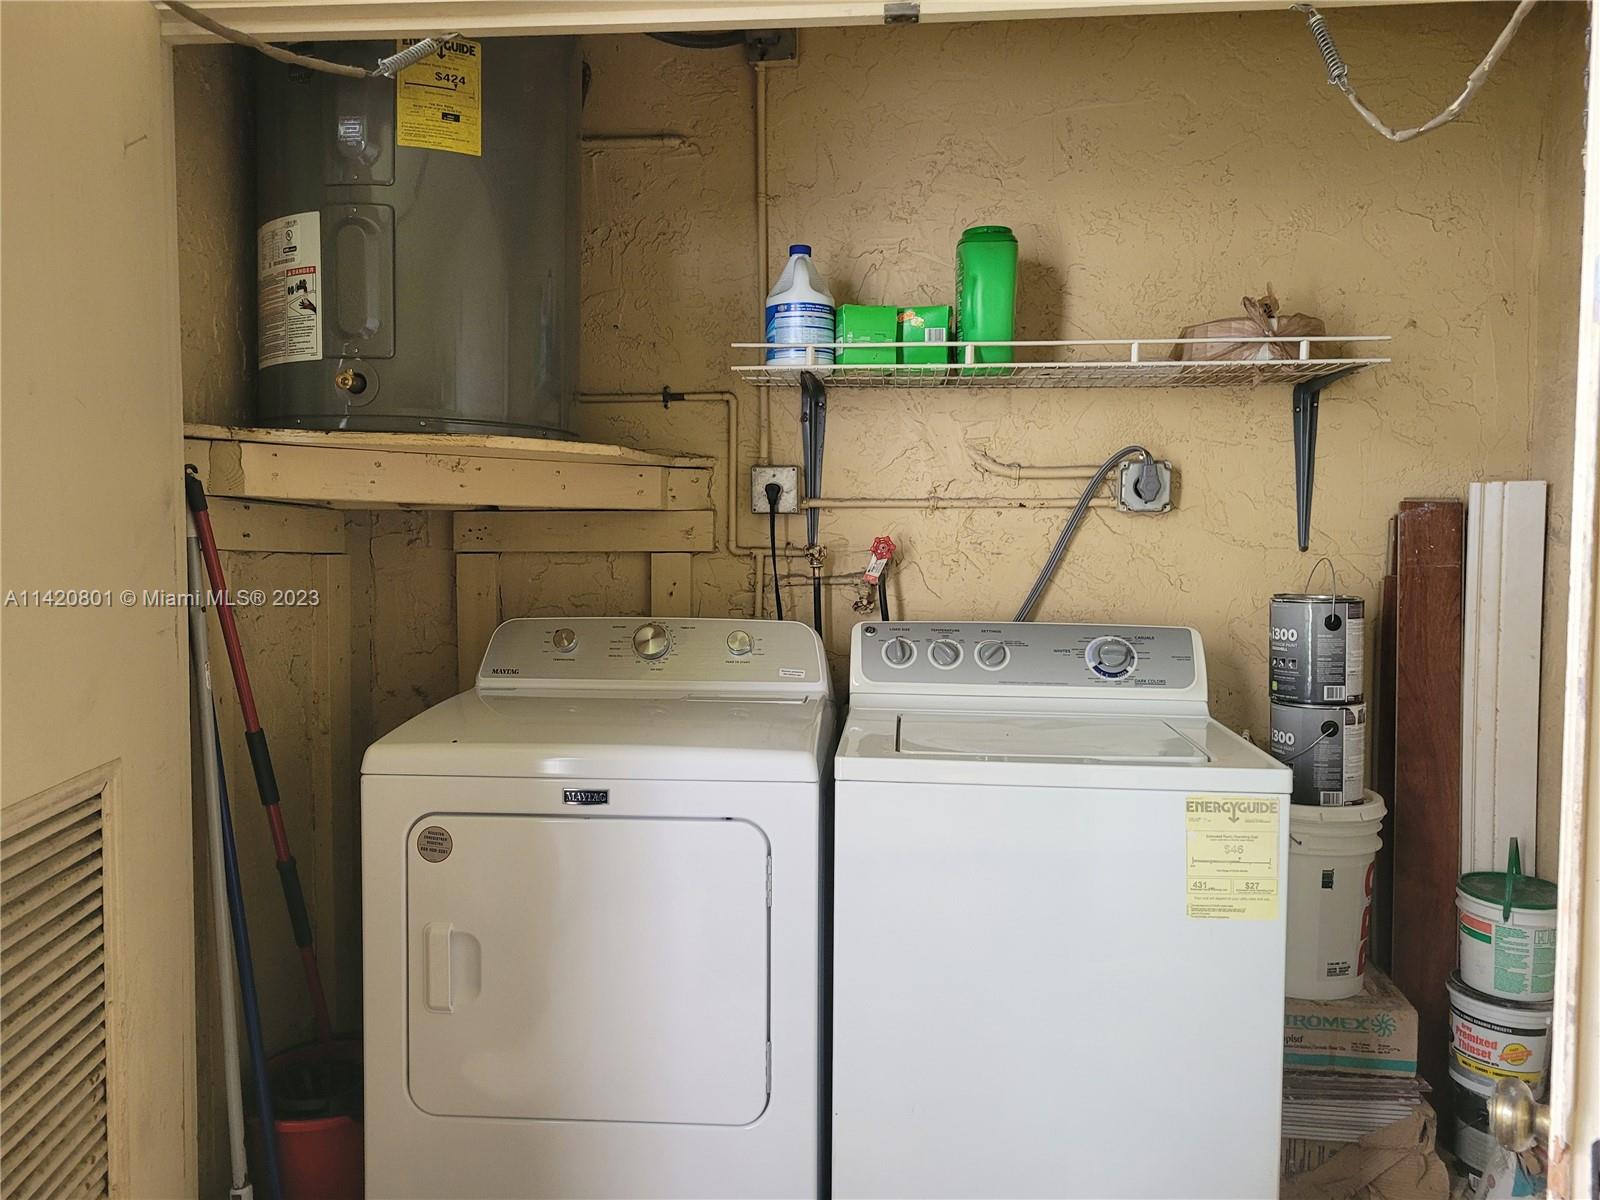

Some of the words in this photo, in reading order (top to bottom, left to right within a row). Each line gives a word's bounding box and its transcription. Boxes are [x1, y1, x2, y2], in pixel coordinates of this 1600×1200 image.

[565, 791, 607, 802] MAYTAG
[1186, 800, 1279, 814] ENERGYGUIDE
[1223, 844, 1244, 855] $46
[1192, 880, 1207, 889] 431
[1245, 882, 1260, 890] $27
[1455, 1025, 1498, 1050] Premixed
[1458, 1038, 1492, 1061] Thinset
